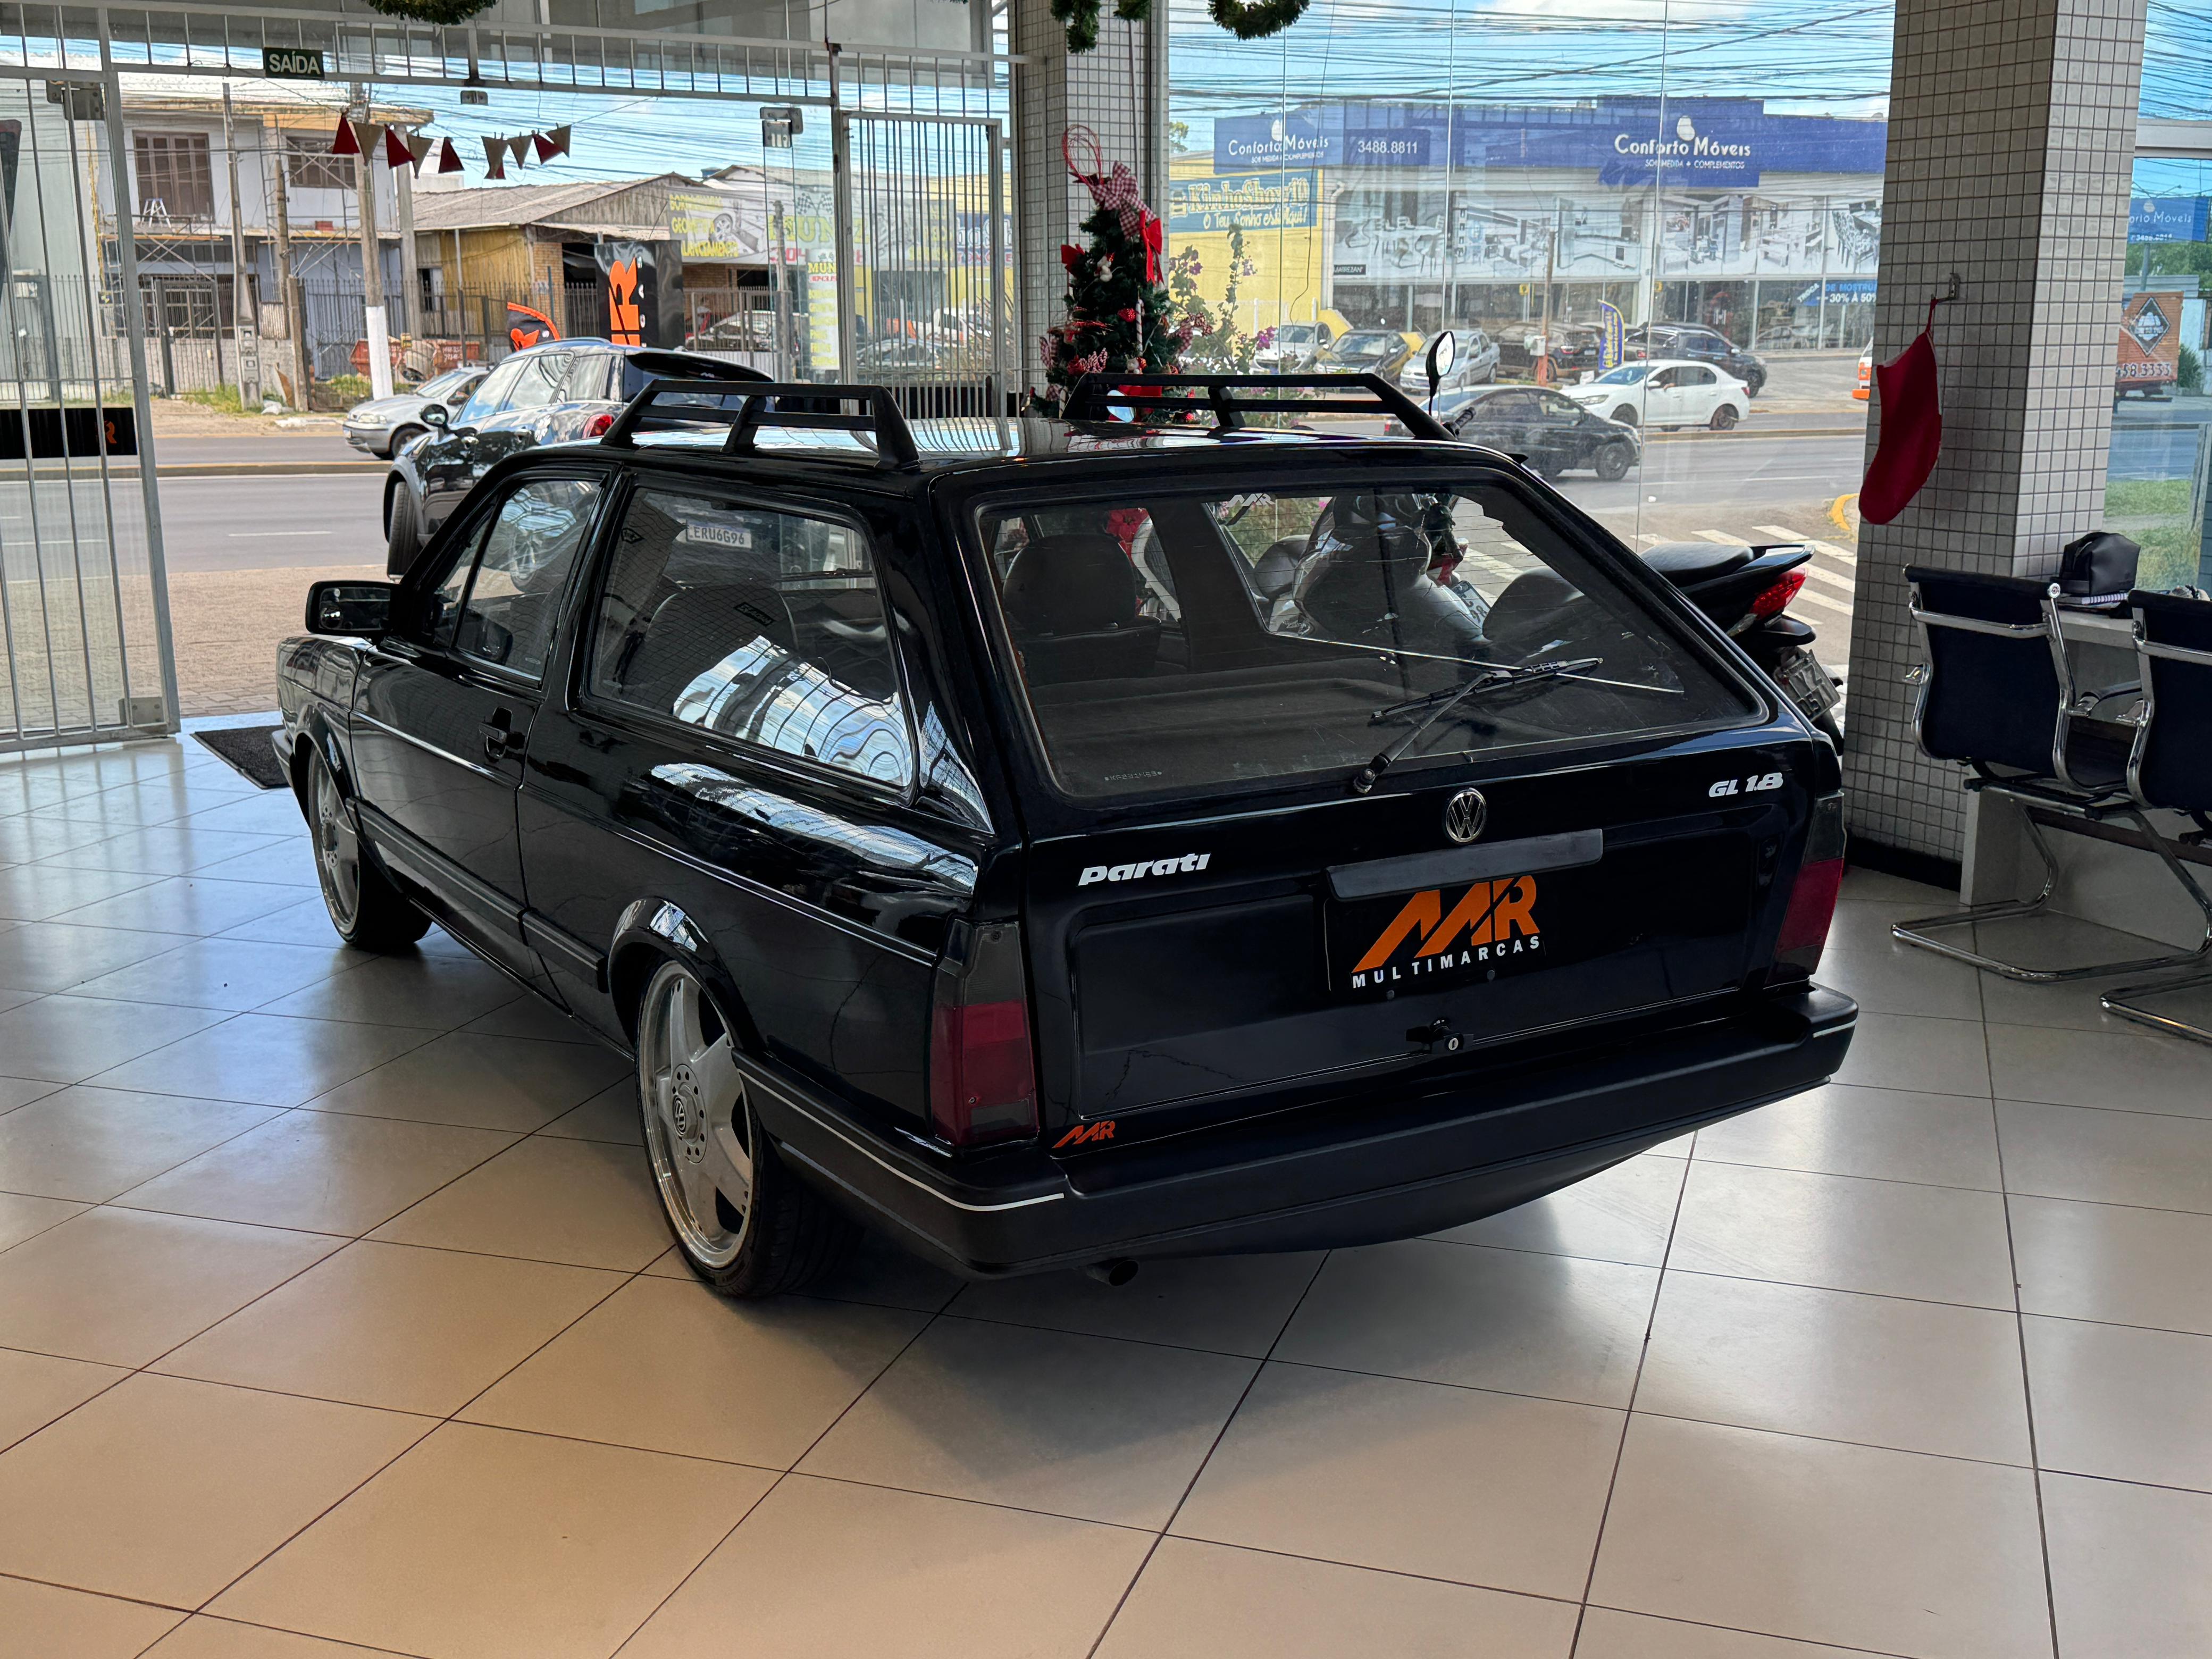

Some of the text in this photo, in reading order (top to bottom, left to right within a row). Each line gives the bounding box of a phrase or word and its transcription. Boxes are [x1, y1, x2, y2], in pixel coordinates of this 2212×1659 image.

[269, 51, 321, 74] SAÍDA
[1228, 134, 1328, 156] Conforto Móveis
[1358, 140, 1418, 154] 3488.8811
[1614, 133, 1751, 157] Conforto Móveis
[1839, 283, 1878, 292] MOSTRU
[694, 526, 745, 545] ERU6G96
[1708, 772, 1784, 798] GL 1.8
[1352, 935, 1540, 989] MULTIMARCAS
